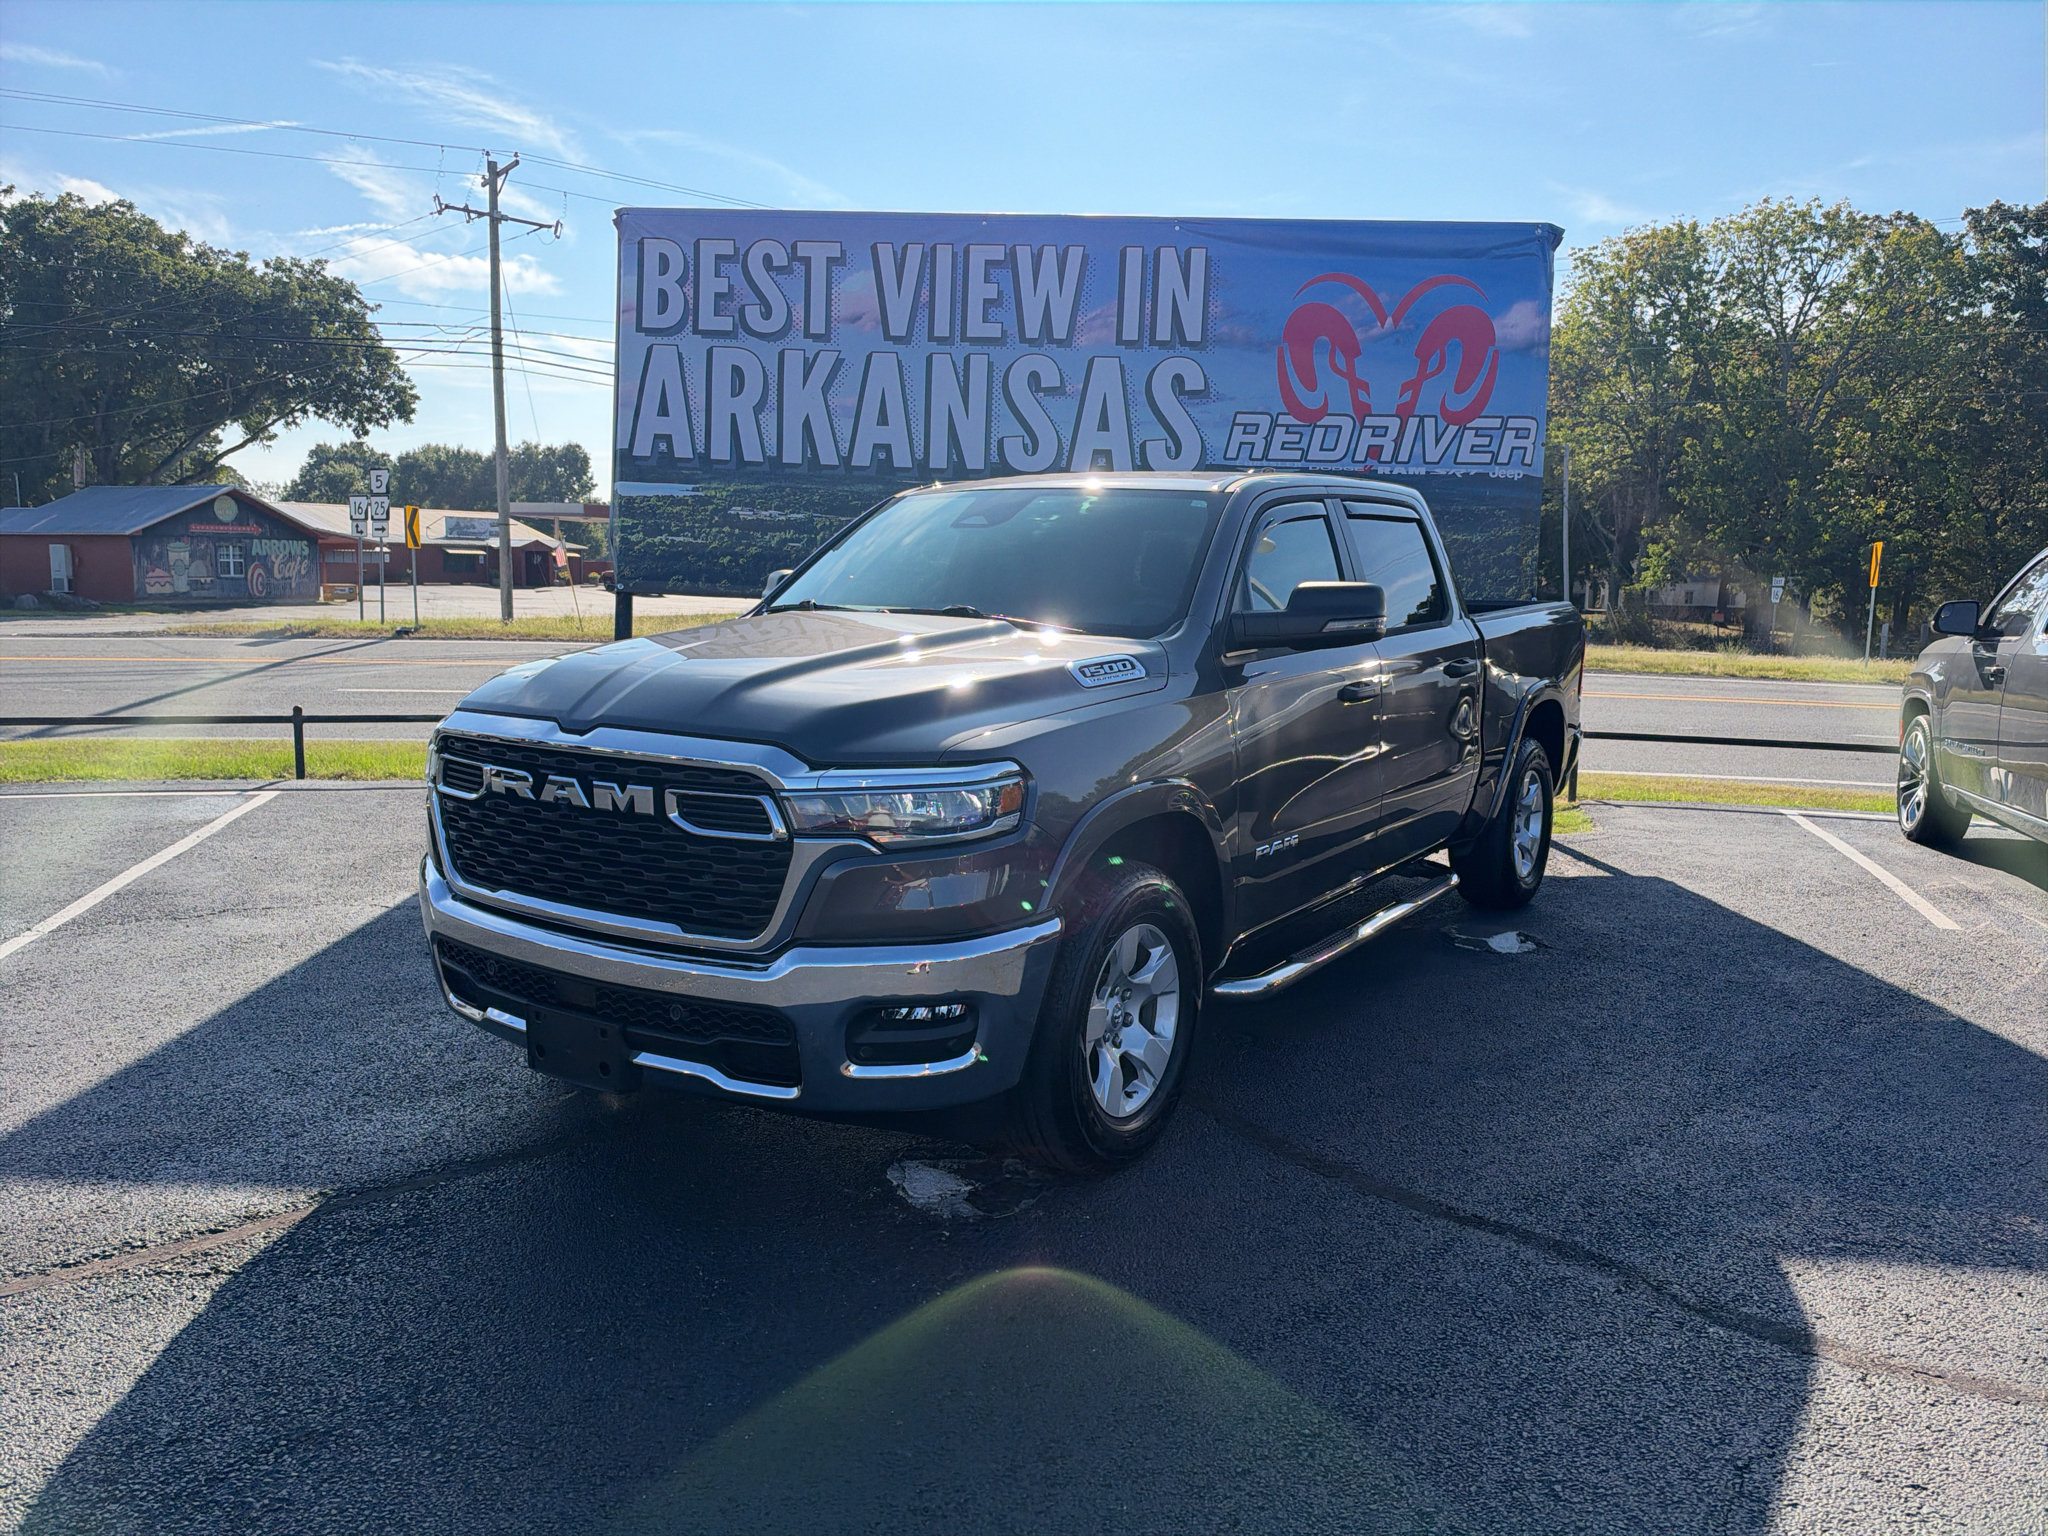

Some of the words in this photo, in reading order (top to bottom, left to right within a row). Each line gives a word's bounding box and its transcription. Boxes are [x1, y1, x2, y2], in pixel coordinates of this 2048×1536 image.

[637, 236, 843, 337] BEST
[870, 242, 1086, 347] VIEW
[1115, 245, 1209, 349] IN
[631, 343, 1208, 473] ARKANSAS
[1223, 410, 1540, 466] REDRIVER
[375, 474, 383, 489] 5
[1377, 466, 1426, 475] RAM
[1488, 466, 1524, 481] Jeep
[353, 501, 364, 515] 16
[374, 501, 386, 516] 25
[251, 538, 310, 556] ARROWS
[1081, 660, 1134, 677] 1500
[490, 765, 655, 815] RAM
[1255, 834, 1299, 861] RAM
